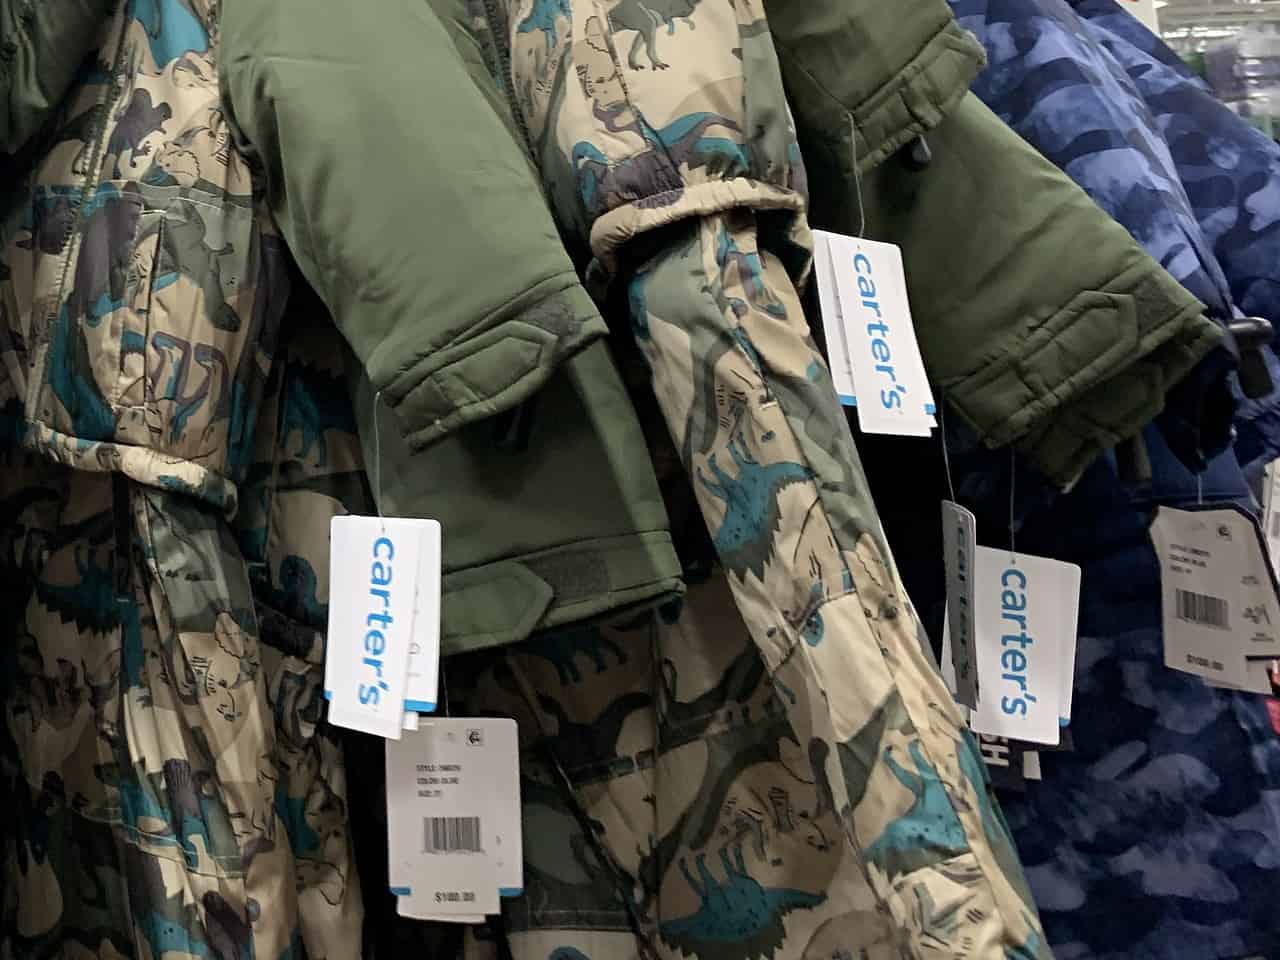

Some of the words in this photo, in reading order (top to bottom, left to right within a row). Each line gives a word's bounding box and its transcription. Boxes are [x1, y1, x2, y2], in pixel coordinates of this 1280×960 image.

[853, 253, 907, 409] carter's
[357, 536, 395, 706] carter's
[1000, 568, 1037, 716] carter's
